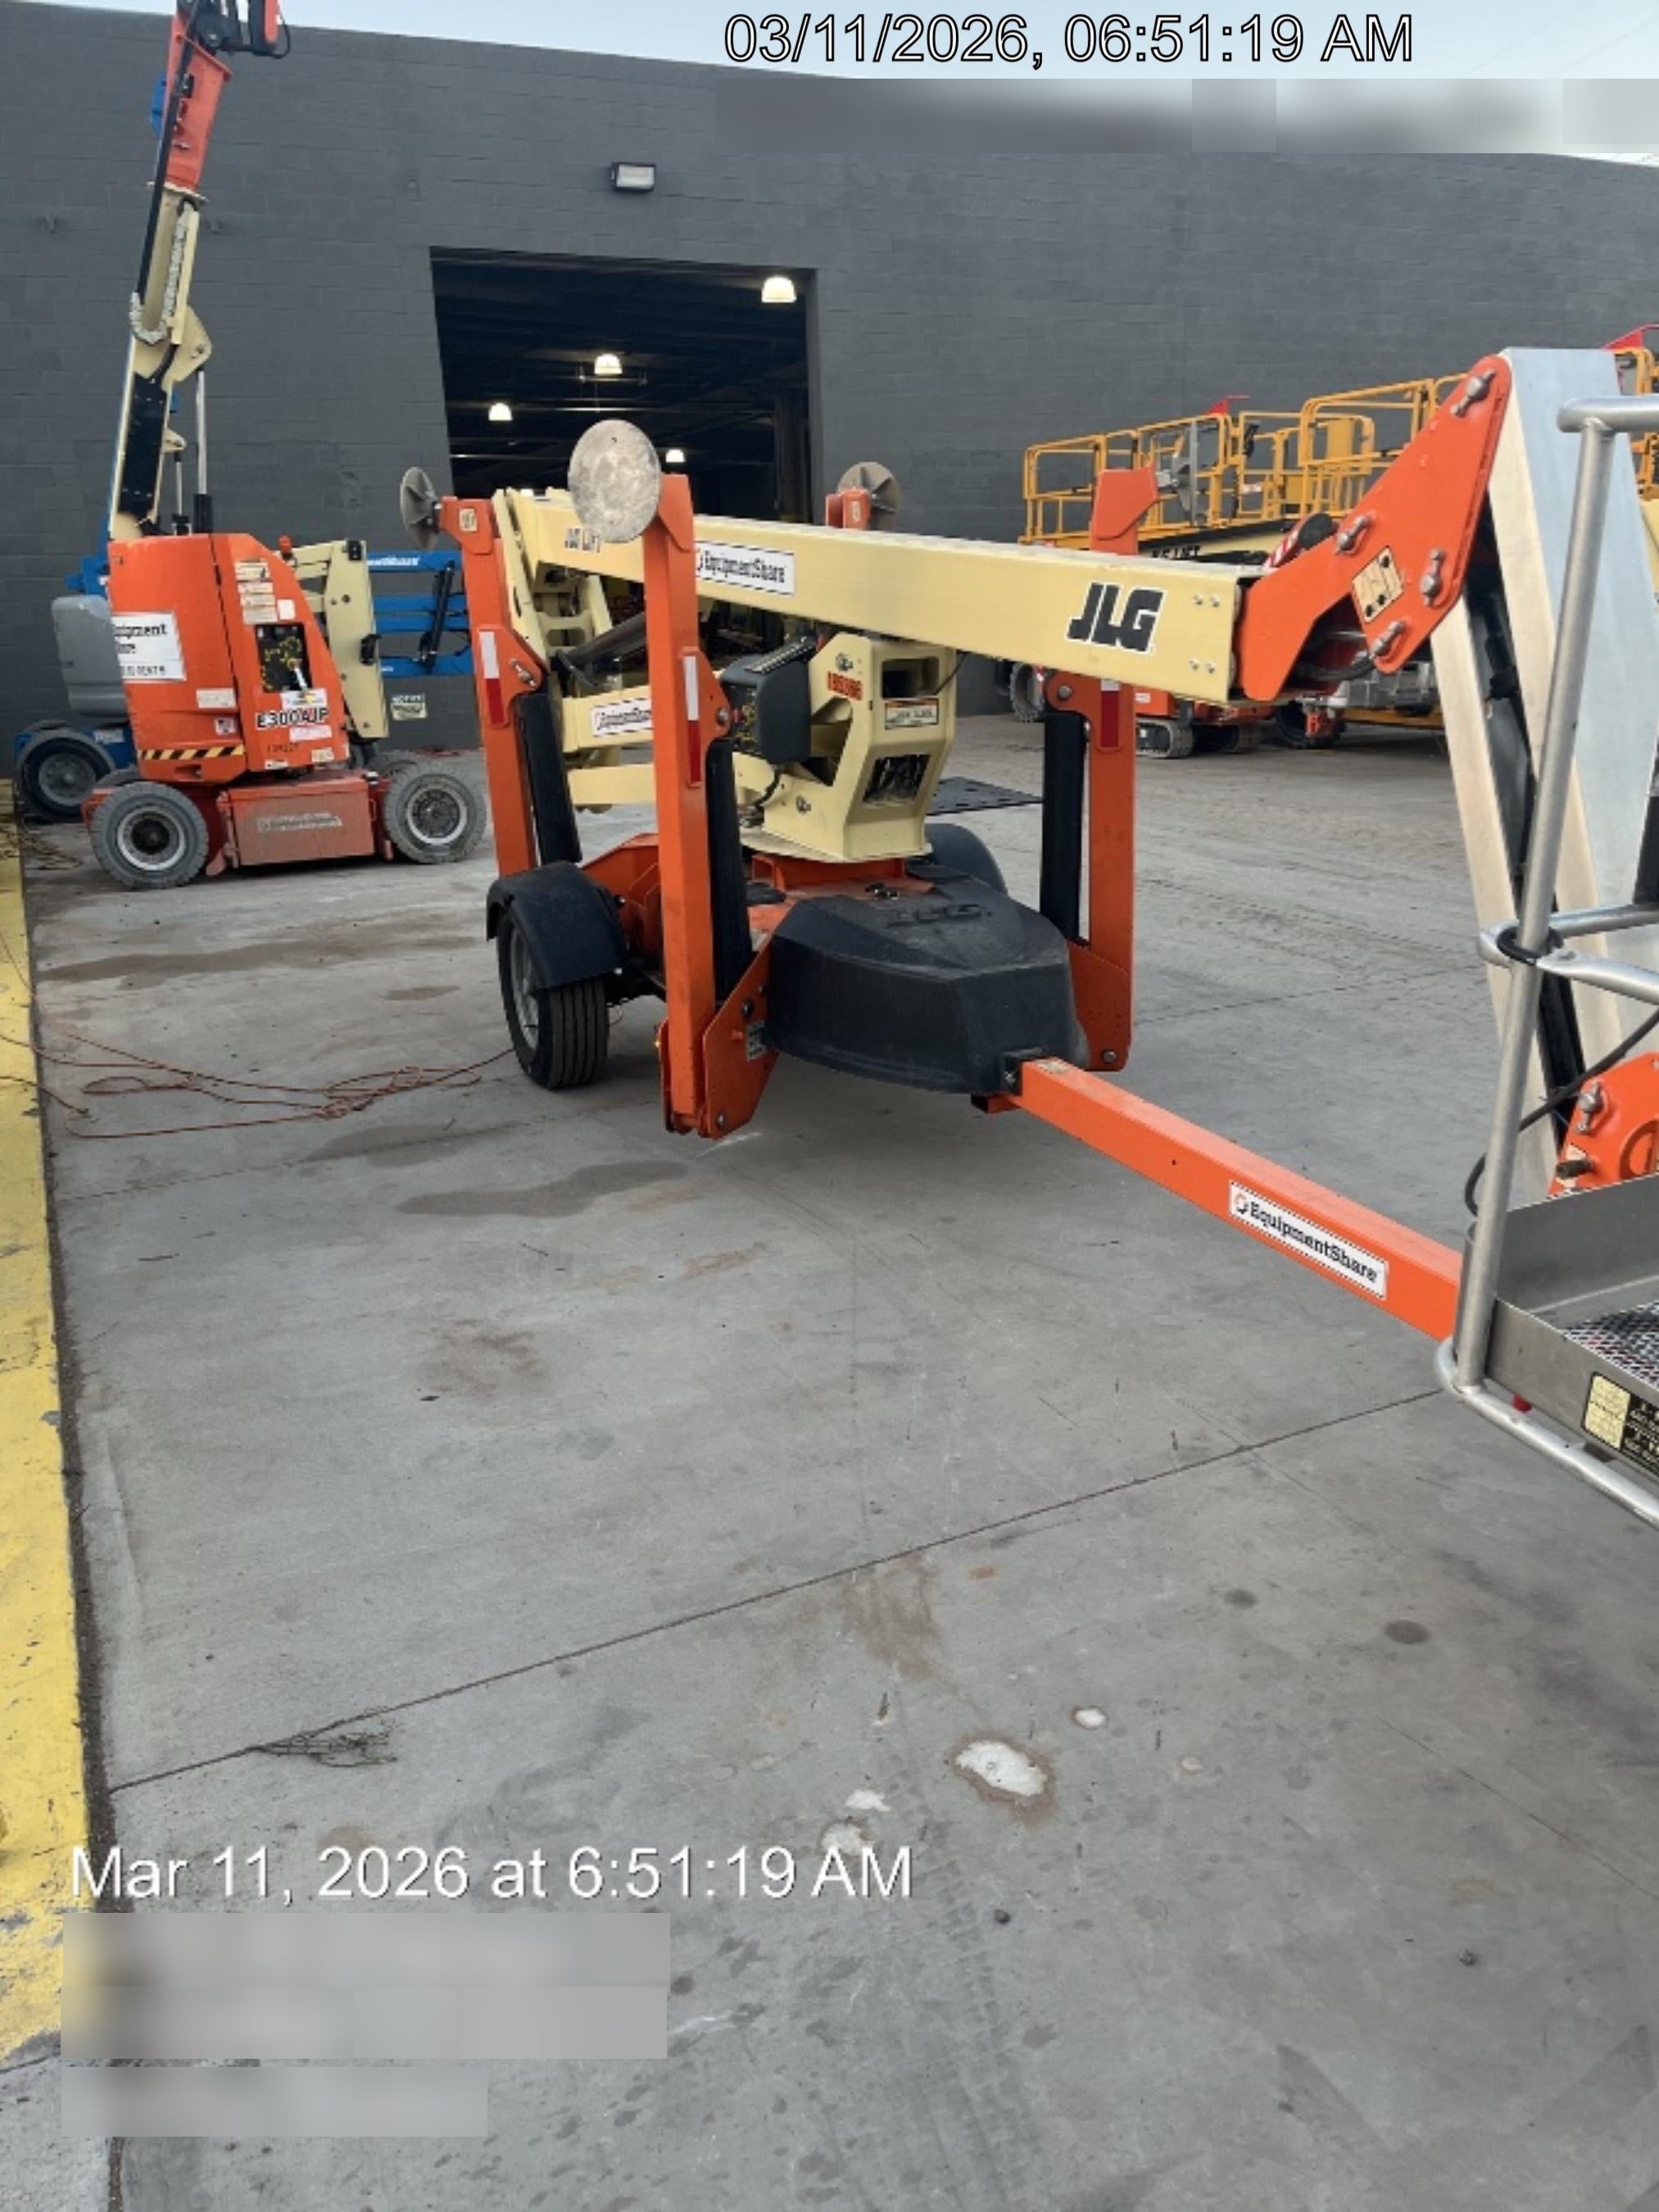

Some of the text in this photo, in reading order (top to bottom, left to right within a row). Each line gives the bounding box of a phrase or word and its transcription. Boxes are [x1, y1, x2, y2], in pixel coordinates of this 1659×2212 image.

[1067, 582, 1163, 653] JLG
[256, 707, 329, 728] E300AJP
[1250, 1200, 1378, 1284] EquipmentShare
